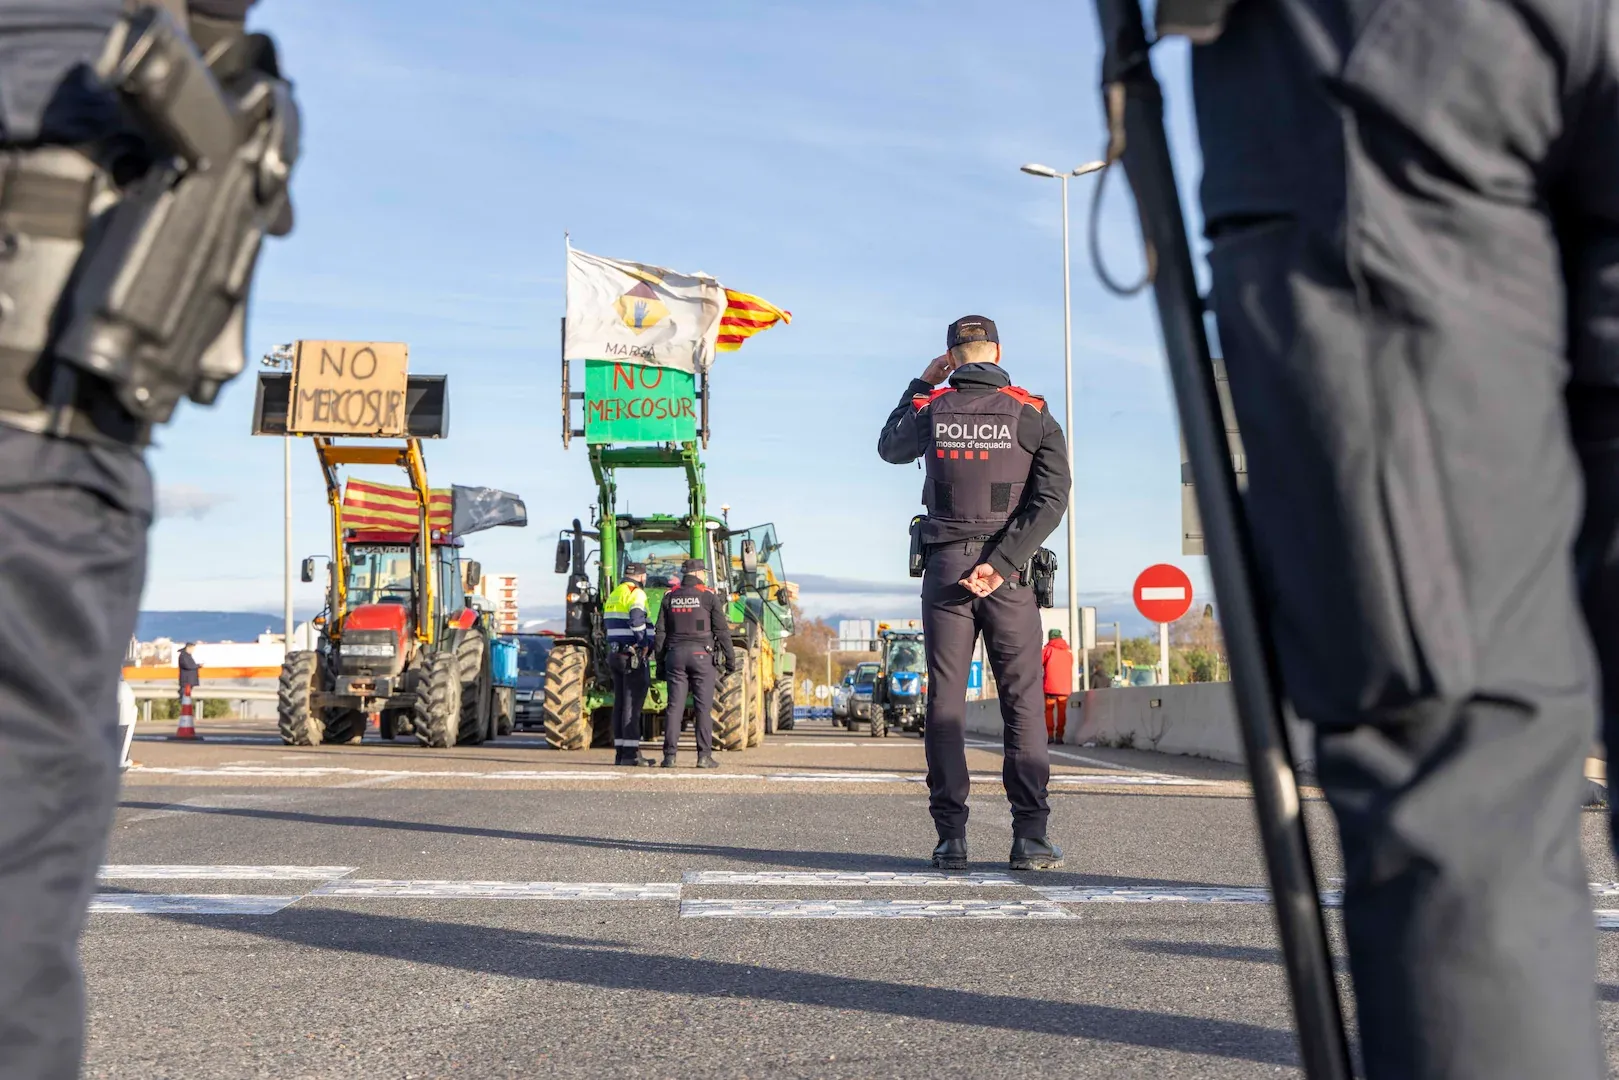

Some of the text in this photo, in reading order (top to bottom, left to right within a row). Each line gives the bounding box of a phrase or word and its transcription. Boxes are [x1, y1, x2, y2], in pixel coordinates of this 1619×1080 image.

[319, 346, 378, 380] NO
[613, 362, 663, 391] NO
[298, 388, 401, 428] MERCOSUR
[588, 397, 697, 424] MERCOSUR
[935, 423, 1012, 440] POLICIA
[936, 440, 1012, 450] mossos d'esquadra
[671, 597, 700, 605] POLICIA
